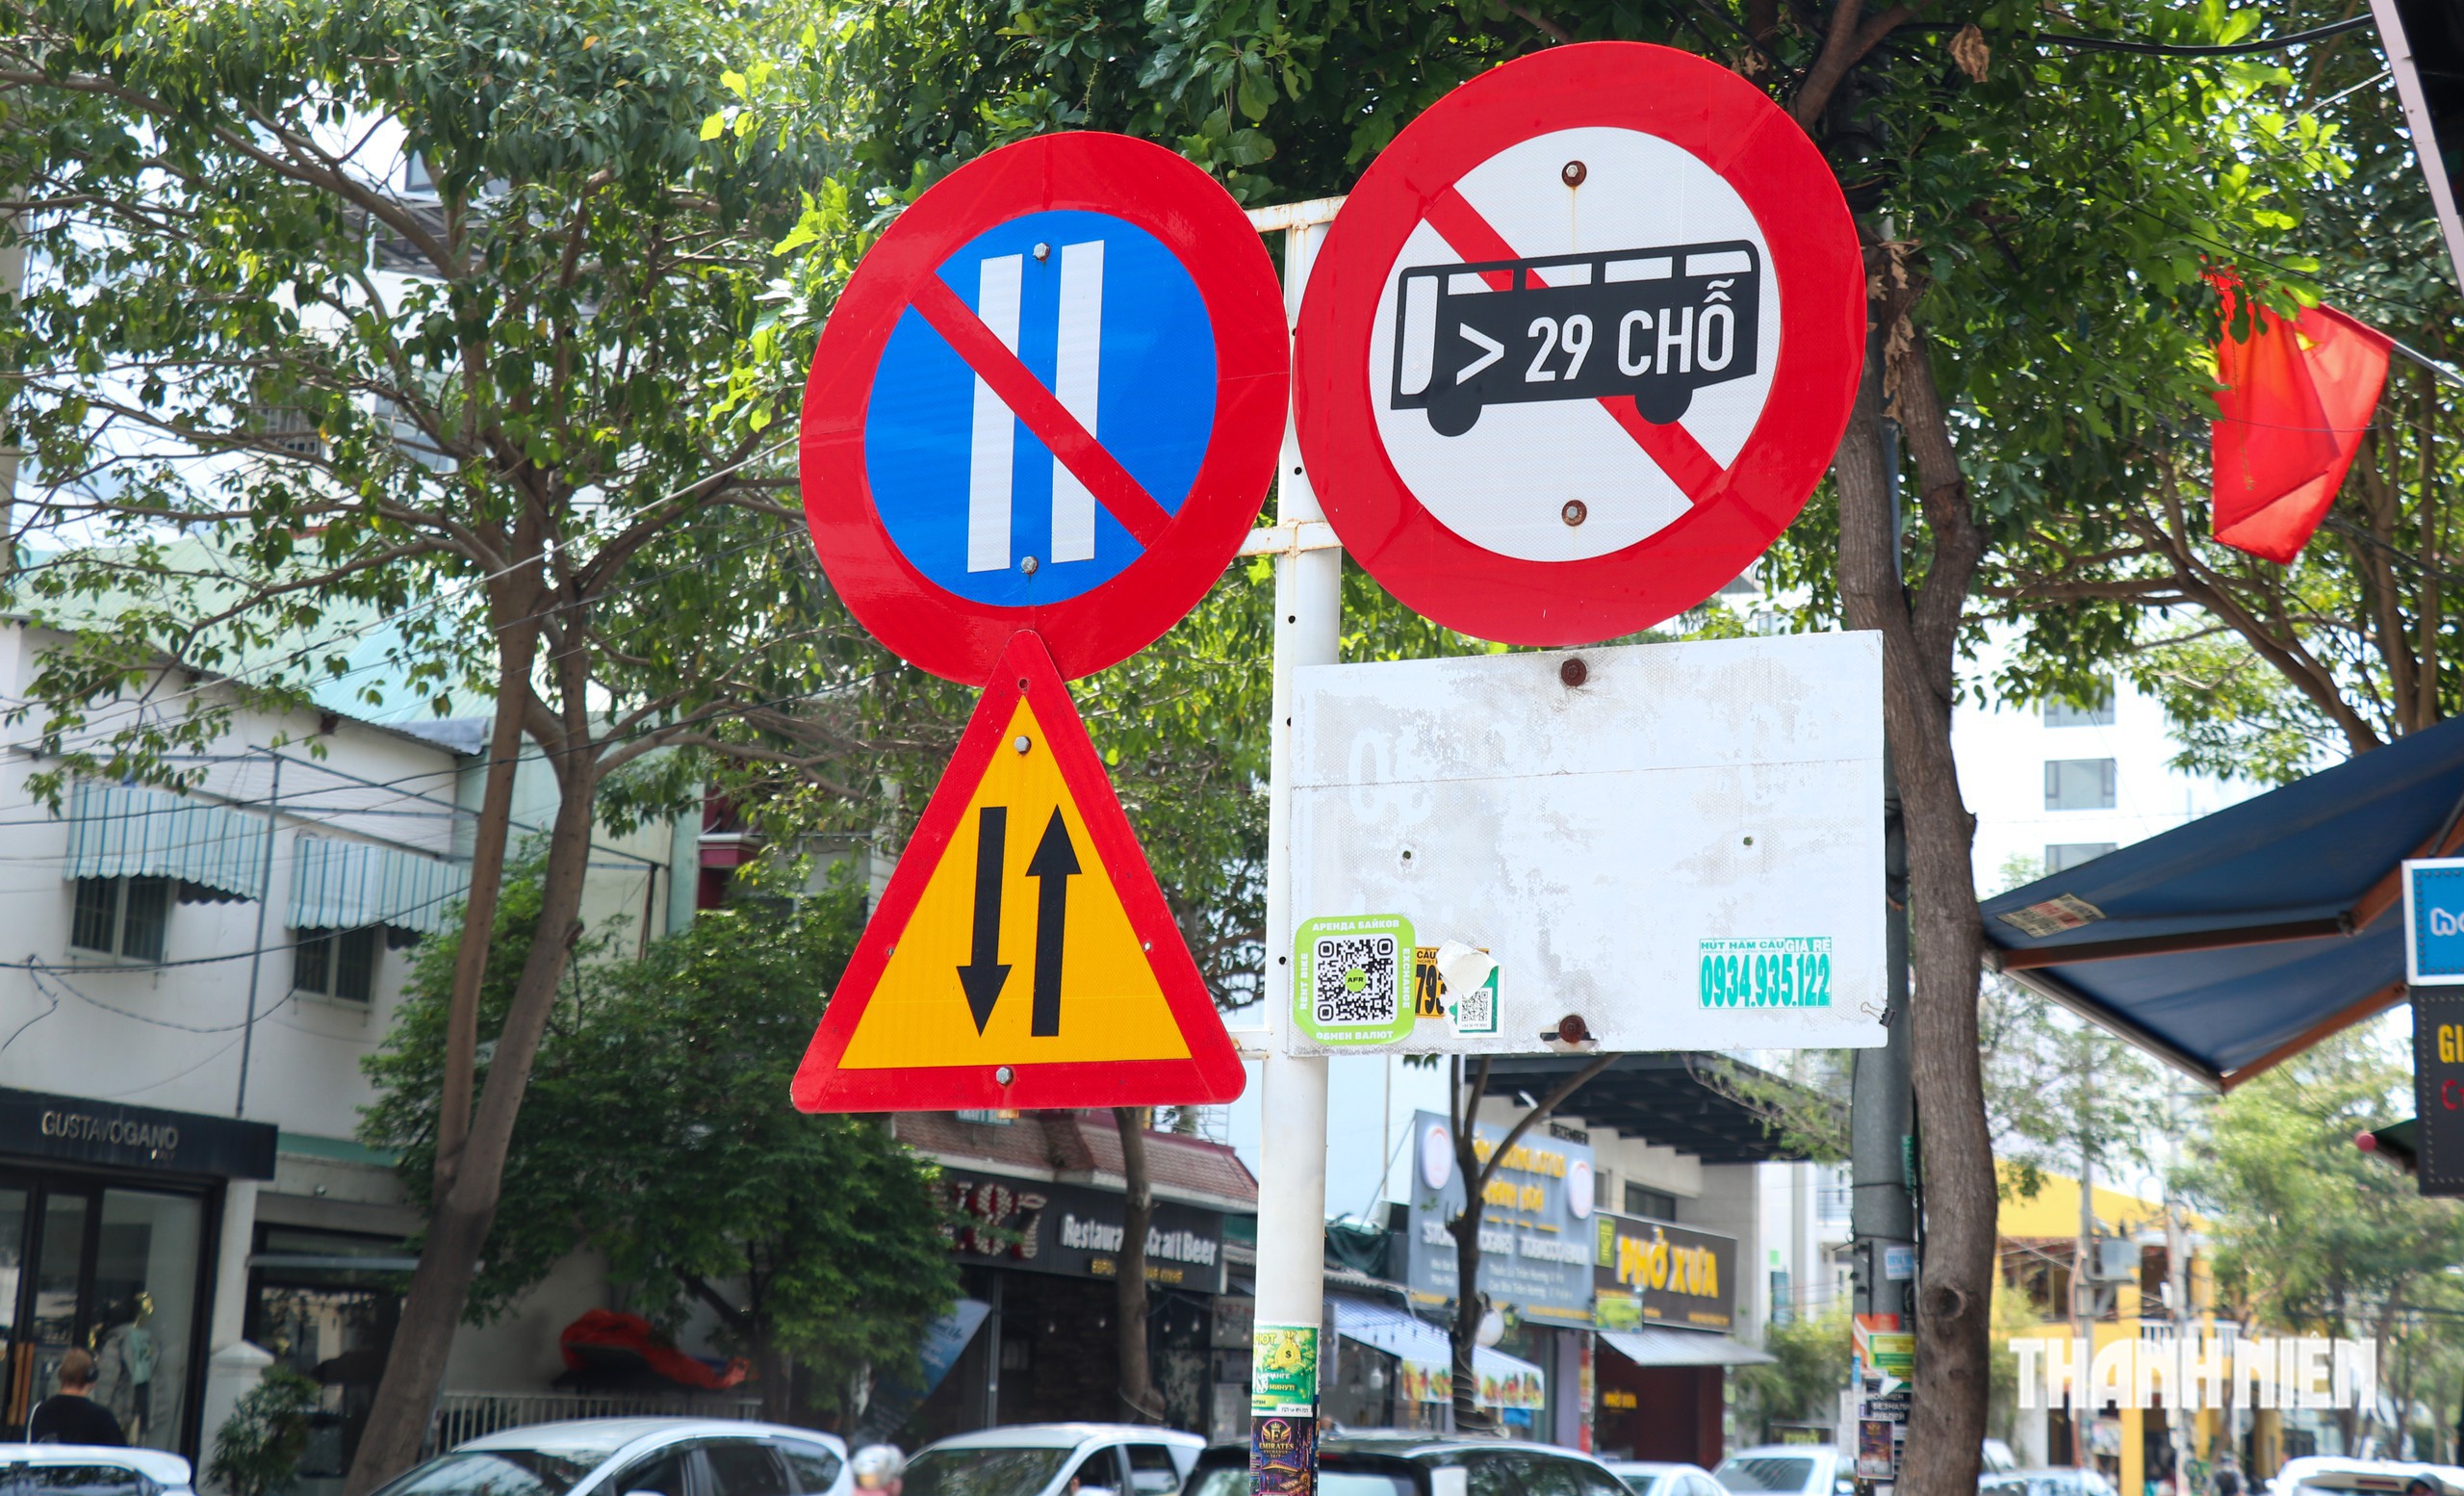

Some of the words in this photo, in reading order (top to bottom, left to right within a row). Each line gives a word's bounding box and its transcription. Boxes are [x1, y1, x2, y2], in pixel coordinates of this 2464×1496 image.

[1525, 314, 1594, 383] 29
[1618, 278, 1735, 377] CHỖ
[1312, 920, 1355, 931] АРЕНДА
[1358, 918, 1399, 930] БАЙКОВ
[1300, 952, 1309, 978] BIKE
[1701, 953, 1831, 1007] 0934.935.122
[1299, 981, 1308, 1010] RENT
[1316, 1031, 1352, 1041] ОБМЕН
[1354, 1030, 1394, 1040] ВАЛЮТ
[1062, 1213, 1124, 1252] Restaura
[1182, 1228, 1218, 1267] Beer
